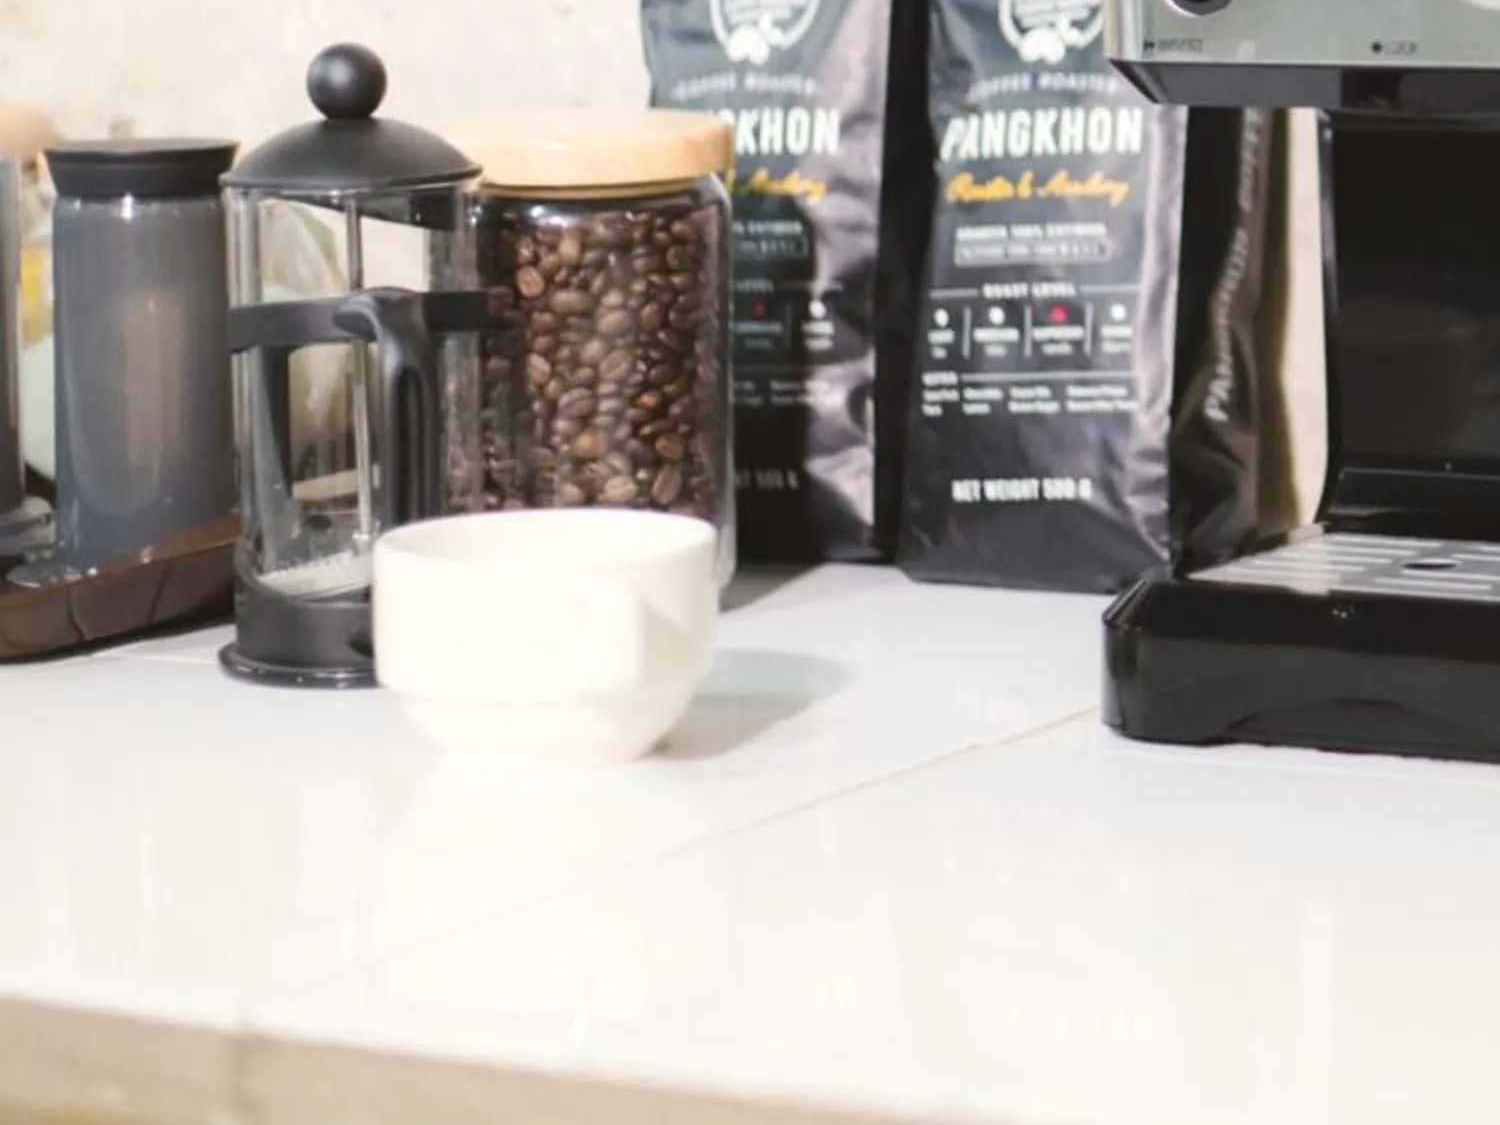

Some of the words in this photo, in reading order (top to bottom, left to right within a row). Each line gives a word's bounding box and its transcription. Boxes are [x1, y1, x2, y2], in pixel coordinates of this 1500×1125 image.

[717, 106, 841, 156] KHON
[939, 106, 1145, 162] PANGKHON
[952, 478, 982, 503] NET
[982, 477, 1040, 502] WEIGHT
